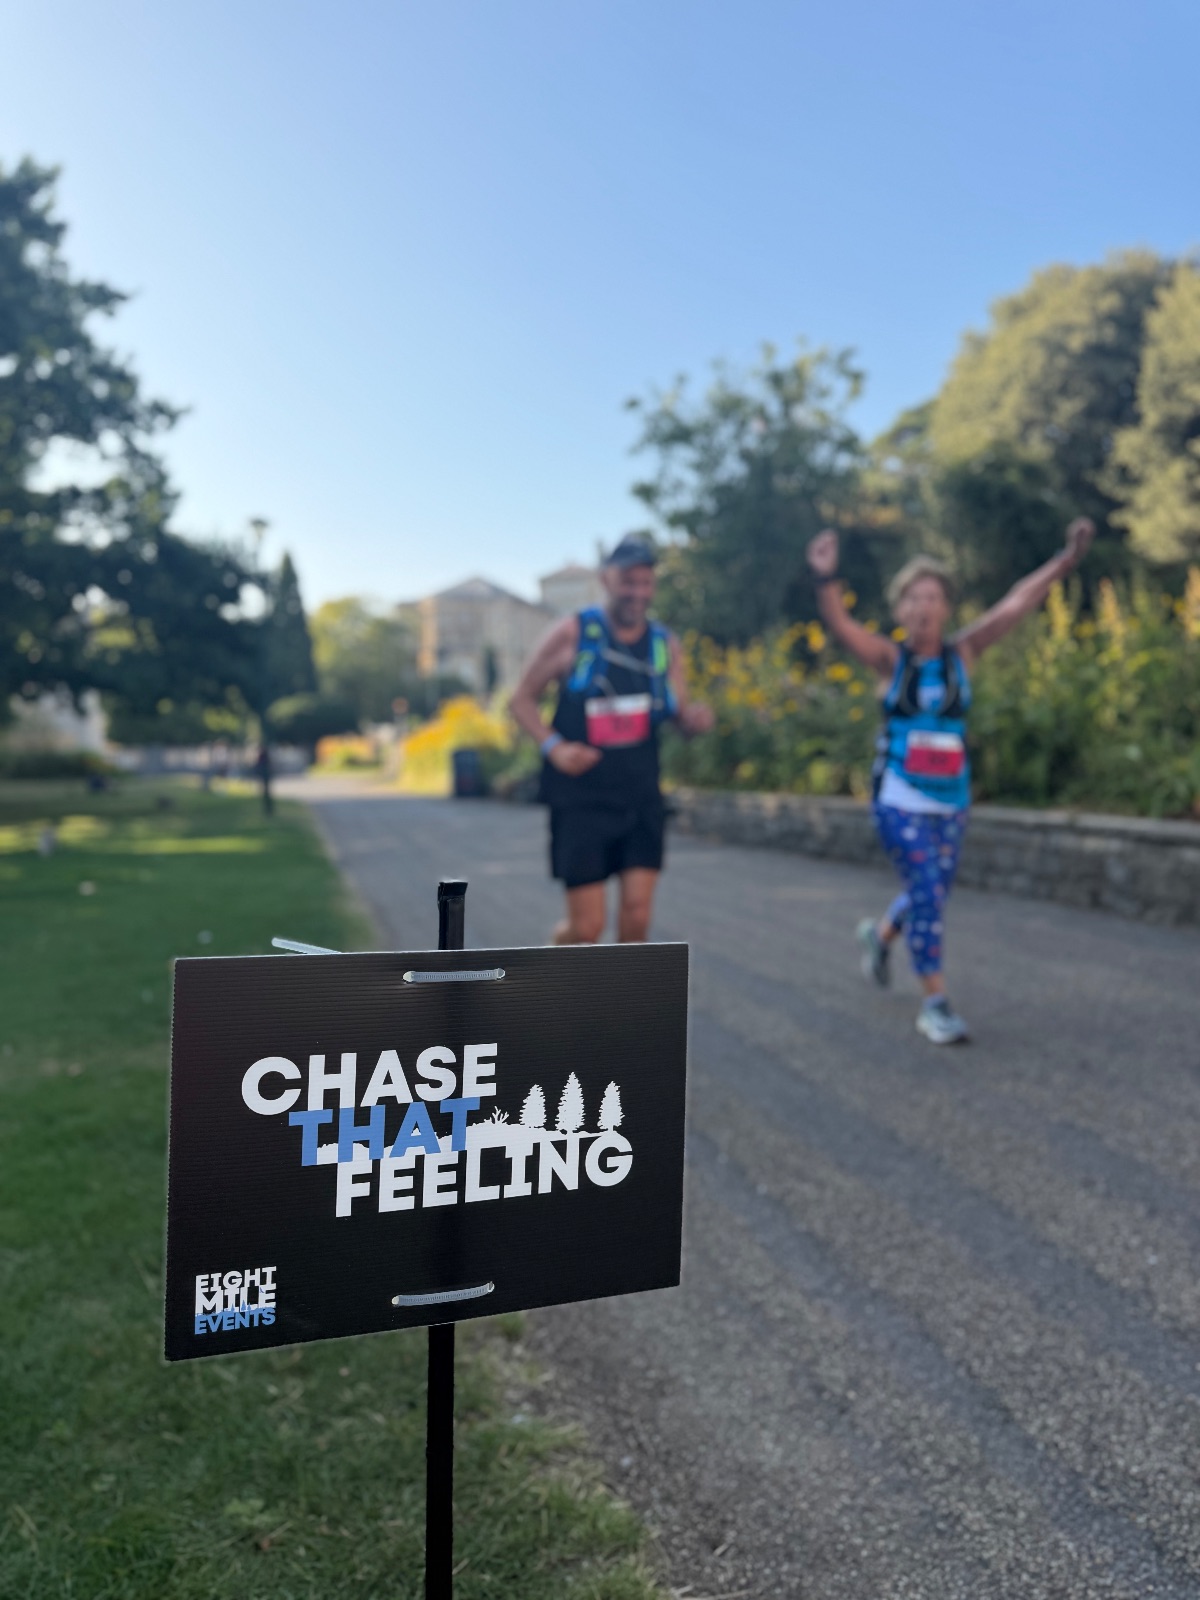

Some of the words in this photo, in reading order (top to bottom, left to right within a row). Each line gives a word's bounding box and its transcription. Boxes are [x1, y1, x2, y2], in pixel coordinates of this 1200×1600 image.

[241, 1043, 498, 1116] CHASE
[289, 1096, 481, 1167] THAT
[335, 1131, 634, 1218] FEELING
[195, 1266, 277, 1293] EIGHT
[195, 1285, 277, 1316] MILE
[194, 1307, 276, 1335] EVENTS
